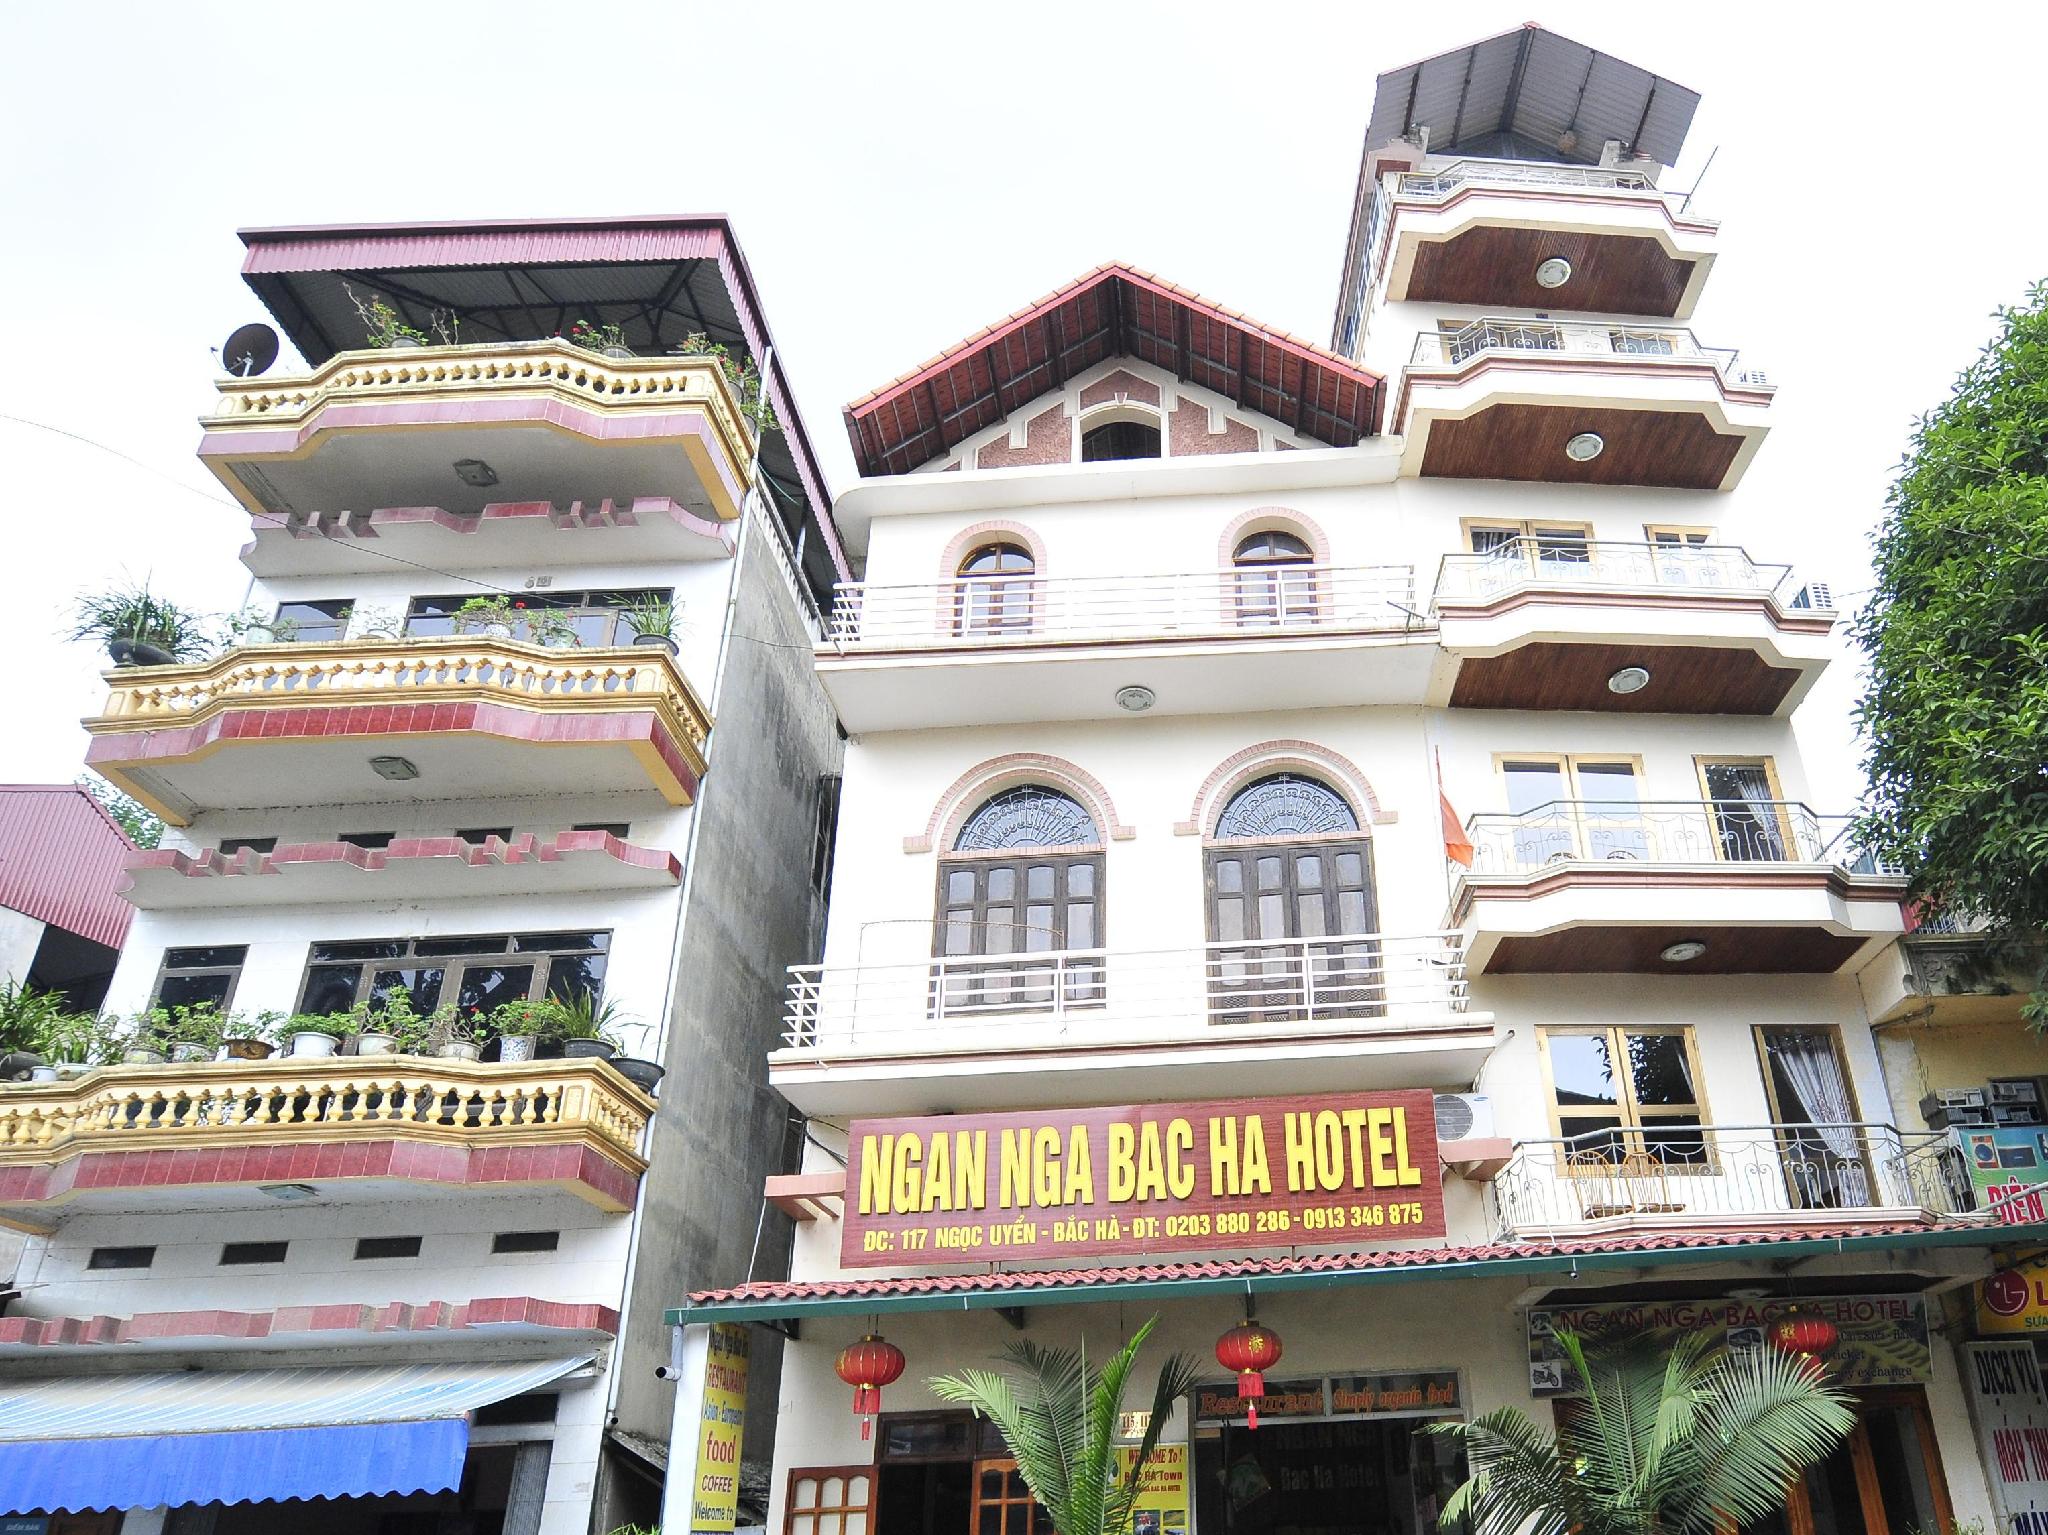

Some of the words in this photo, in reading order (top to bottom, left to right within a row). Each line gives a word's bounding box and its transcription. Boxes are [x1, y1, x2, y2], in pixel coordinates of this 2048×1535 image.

[858, 1130, 988, 1215] NGAN
[999, 1124, 1095, 1208] NGA
[1108, 1117, 1196, 1203] BAC
[1208, 1115, 1272, 1197] HA
[1284, 1106, 1422, 1191] HOTEL
[863, 1230, 895, 1252] ĐC:
[900, 1228, 928, 1250] 117
[934, 1226, 983, 1253] NGỌC
[989, 1215, 1036, 1246] UYỂN
[1053, 1215, 1089, 1243] BẮC
[1165, 1214, 1211, 1237] 0203
[1216, 1212, 1250, 1235] 880
[1256, 1210, 1290, 1232] 286
[1303, 1206, 1346, 1230] 0913
[1350, 1204, 1384, 1227] 346
[1389, 1202, 1423, 1225] 875
[1559, 1309, 1644, 1329] NGAN
[1653, 1306, 1717, 1328] NGA
[1726, 1304, 1778, 1327] BAC
[1836, 1300, 1915, 1322] HOTEL
[705, 1363, 747, 1396] RESTAURANT
[1858, 1366, 1911, 1379] exchange
[1427, 1381, 1454, 1406] food
[706, 1430, 737, 1464] food
[702, 1474, 733, 1493] COFFEE
[695, 1500, 725, 1520] Welcome
[726, 1506, 734, 1521] to
